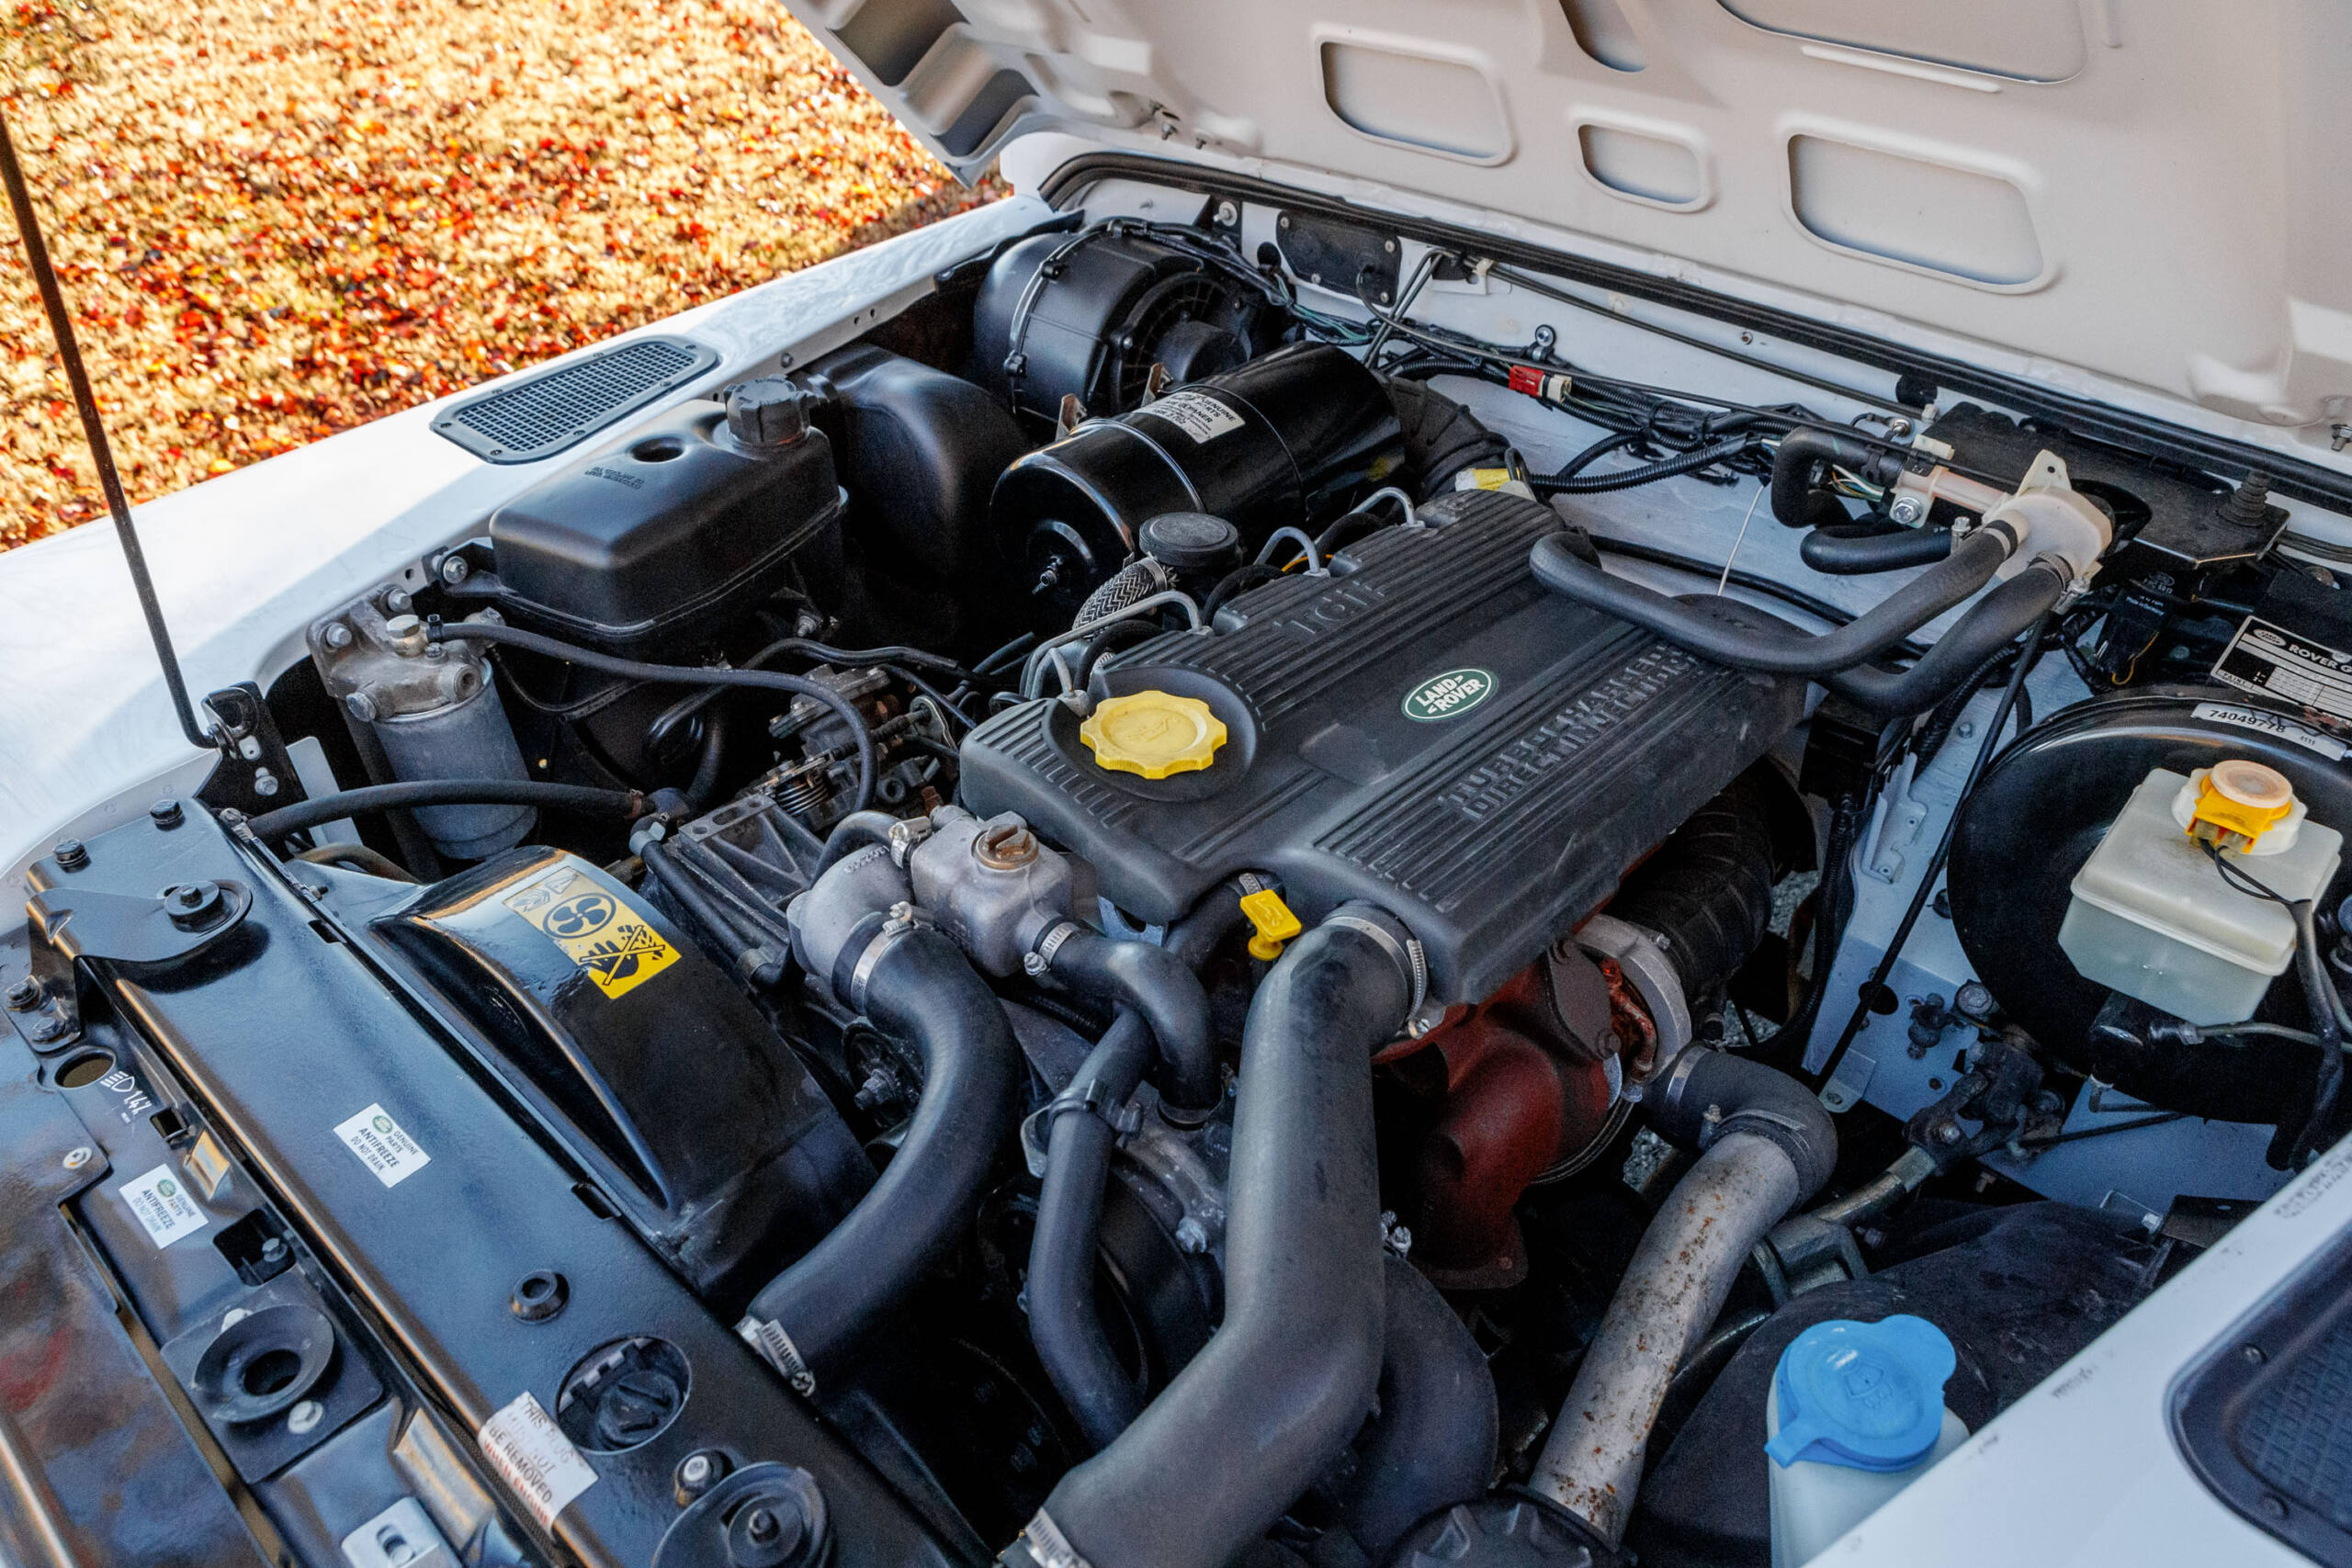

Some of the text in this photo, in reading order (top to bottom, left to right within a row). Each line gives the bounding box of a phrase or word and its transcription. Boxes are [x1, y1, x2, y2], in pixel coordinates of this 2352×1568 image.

[2289, 644, 2339, 670] ROVER
[1415, 677, 1461, 706] LAND
[1430, 679, 1485, 713] ROVER
[2209, 709, 2287, 734] 74049778
[351, 1135, 362, 1146] DO
[359, 1143, 372, 1156] NOT
[358, 1127, 400, 1168] ANTIFREEZE
[386, 1135, 403, 1154] PARTS
[393, 1131, 419, 1156] GENUINE
[141, 1189, 175, 1230] ANTIFREEZE
[521, 1395, 548, 1429] THIS
[489, 1426, 552, 1504] BE REMOVED
